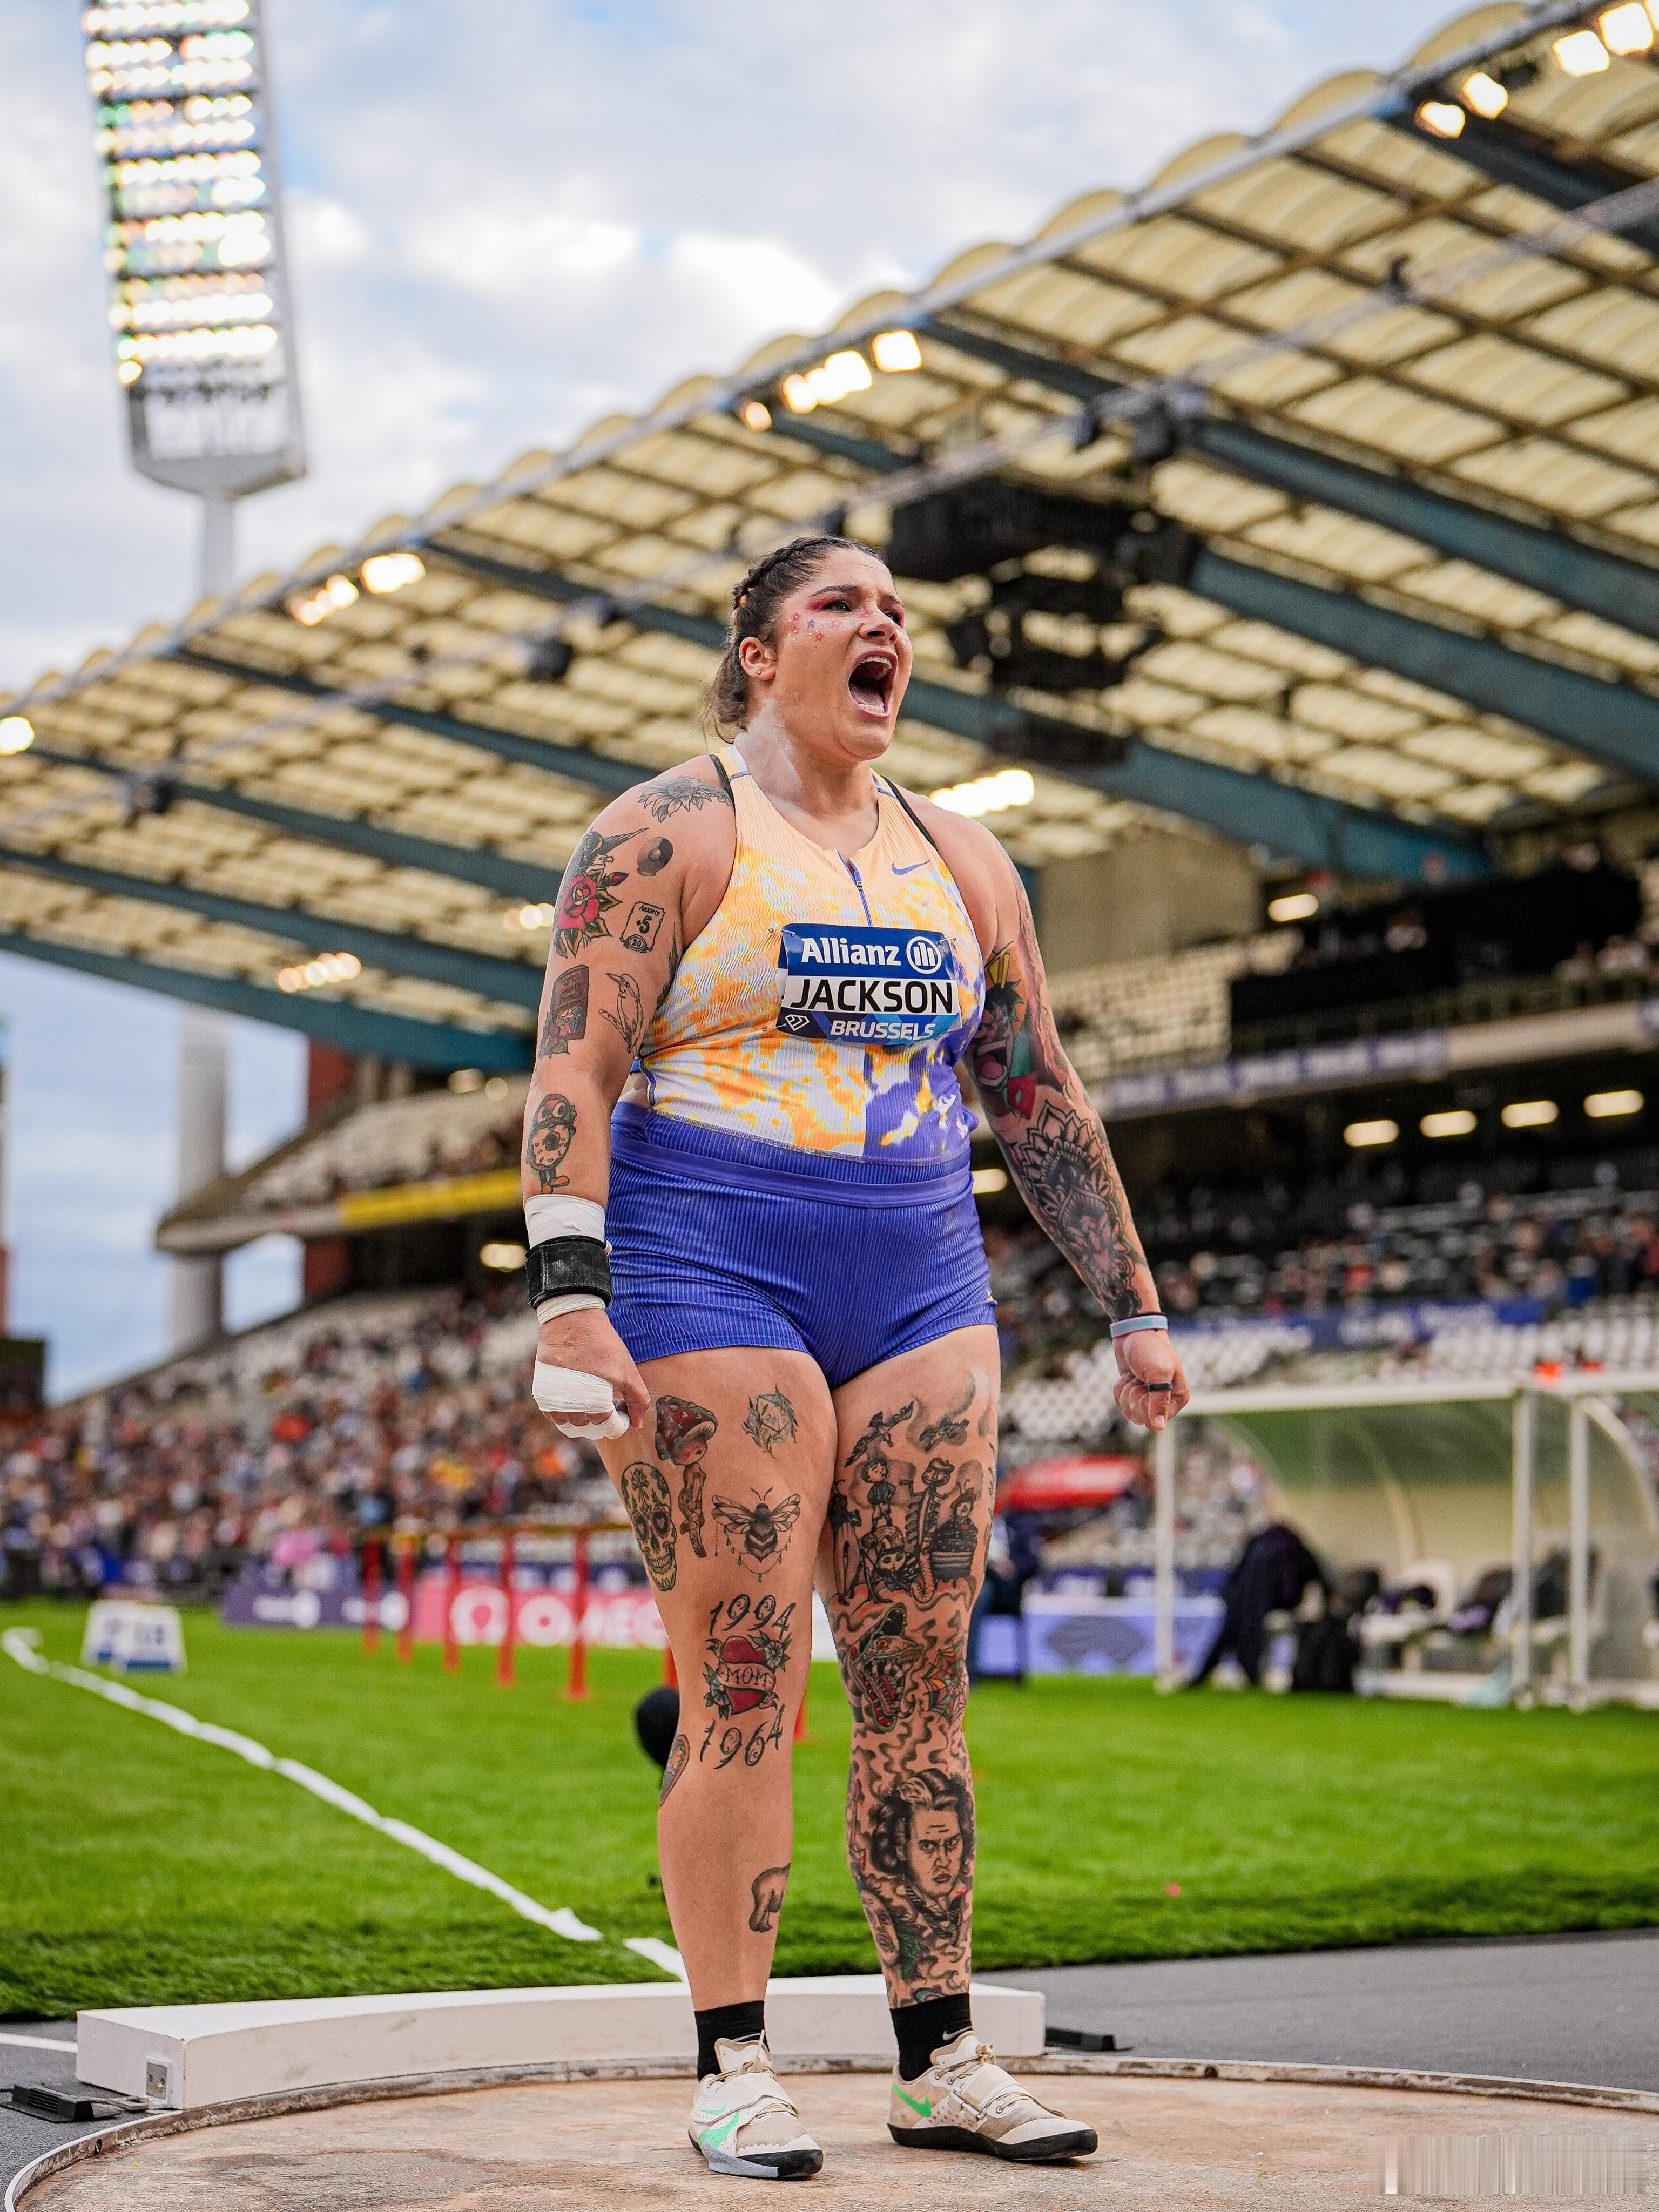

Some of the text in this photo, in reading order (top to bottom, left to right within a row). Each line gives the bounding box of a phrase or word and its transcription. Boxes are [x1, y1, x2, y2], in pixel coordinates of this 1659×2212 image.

[639, 904, 660, 917] Anxiety
[632, 939, 642, 947] 20
[801, 938, 901, 966] Allianz
[790, 979, 953, 1014] JACKSON
[830, 1020, 936, 1041] BRUSSELS
[709, 1594, 797, 1640] 1994
[725, 1665, 770, 1687] MOM
[700, 1704, 785, 1769] 1964
